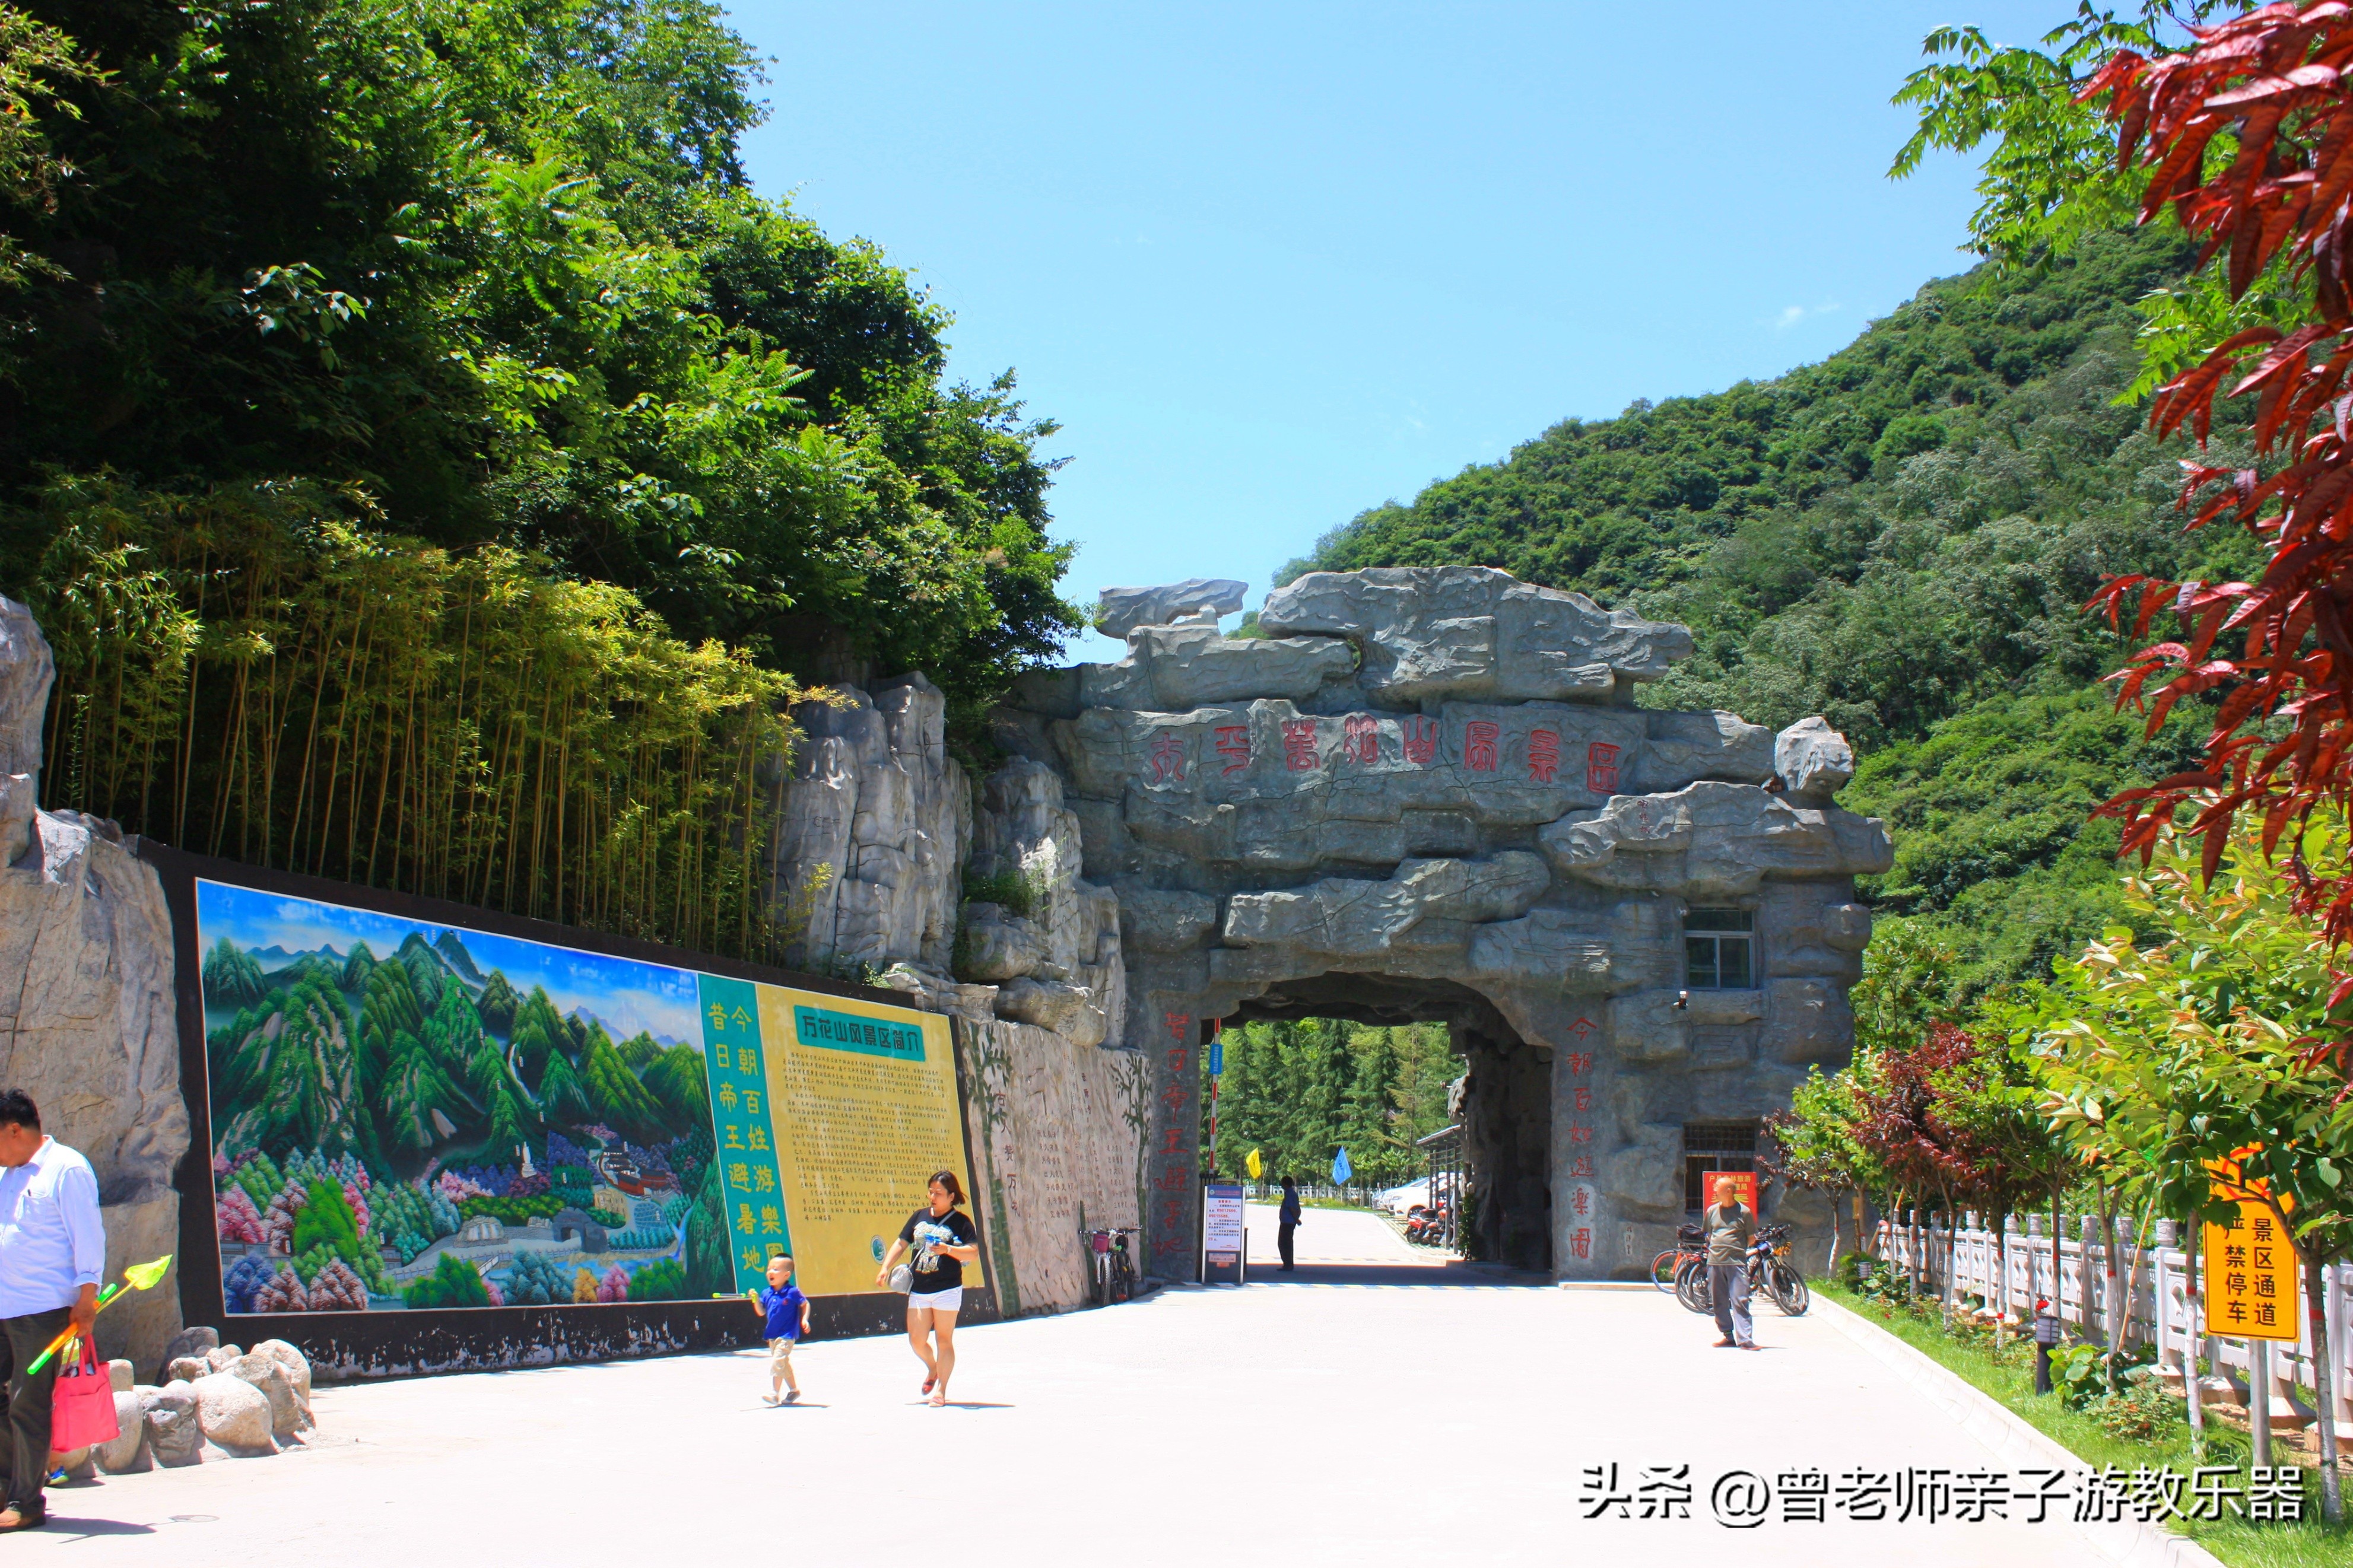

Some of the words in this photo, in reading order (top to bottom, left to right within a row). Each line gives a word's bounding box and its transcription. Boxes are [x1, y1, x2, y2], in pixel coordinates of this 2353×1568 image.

[802, 1015, 919, 1052] 万花山风景区简介
[708, 1001, 766, 1273] 昔日帝王避暑地
[2252, 1218, 2276, 1327] 景区通道
